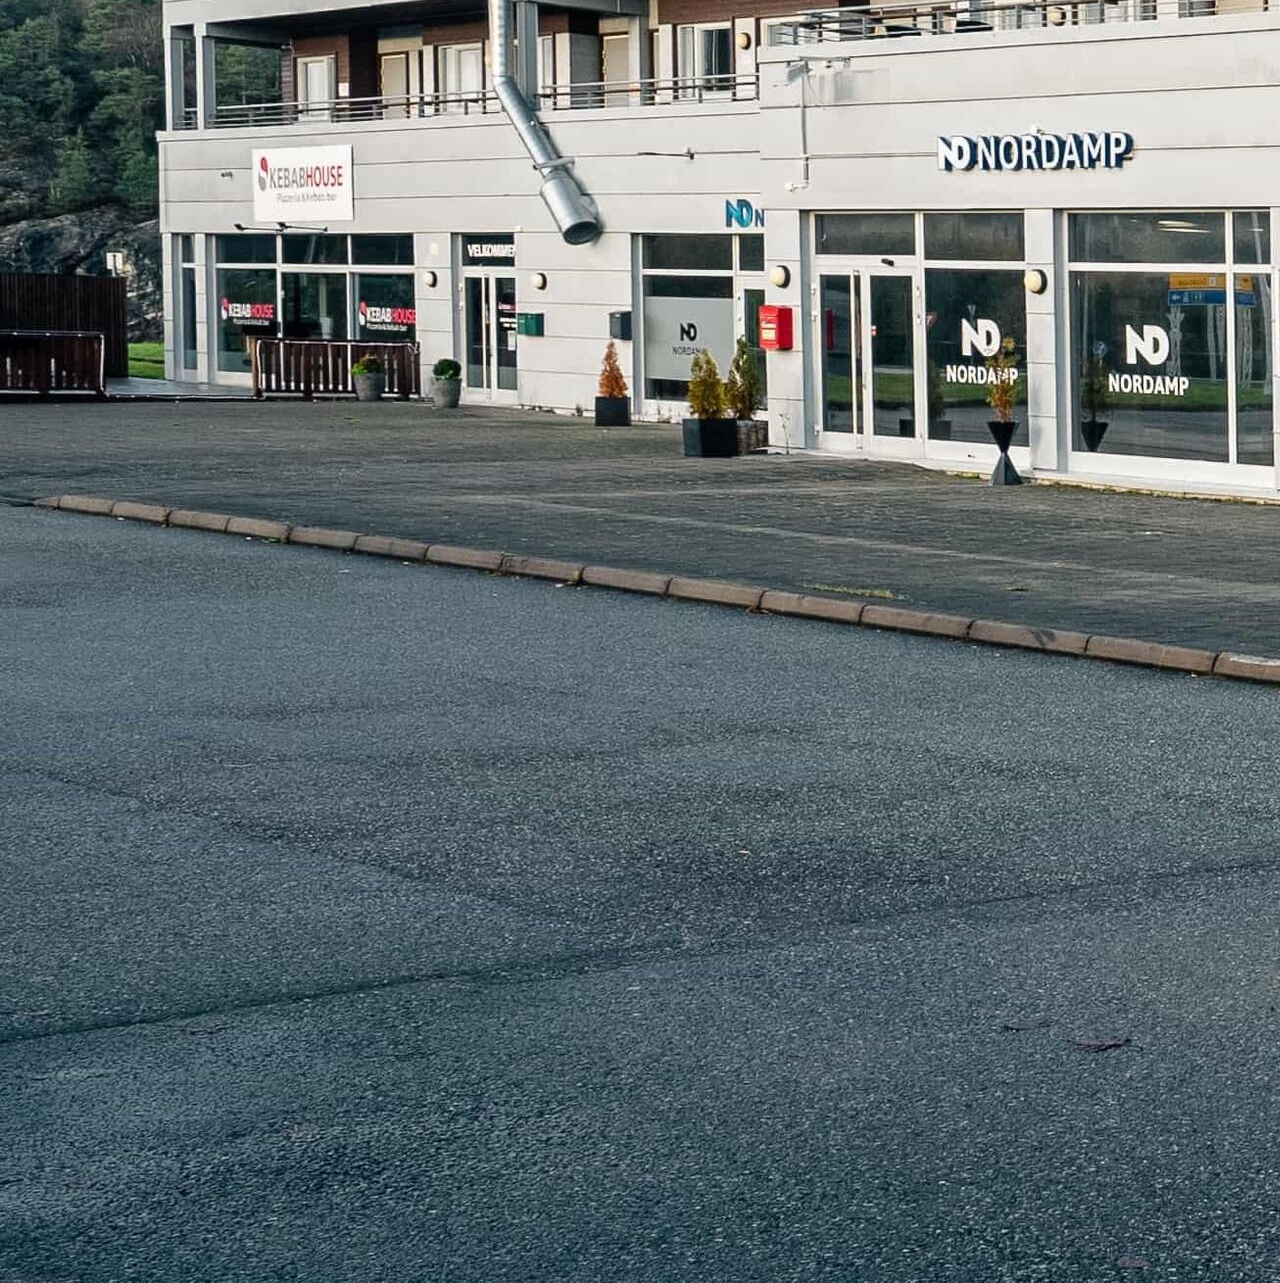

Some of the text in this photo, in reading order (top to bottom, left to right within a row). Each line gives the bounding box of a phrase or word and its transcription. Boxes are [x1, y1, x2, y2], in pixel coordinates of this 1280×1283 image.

[977, 131, 1133, 172] NORDAMP
[269, 165, 343, 189] KEBABHOUSE
[467, 244, 517, 258] VELKOMME
[228, 303, 273, 318] KEBABHOUSE
[1108, 373, 1190, 396] NORDAMP
